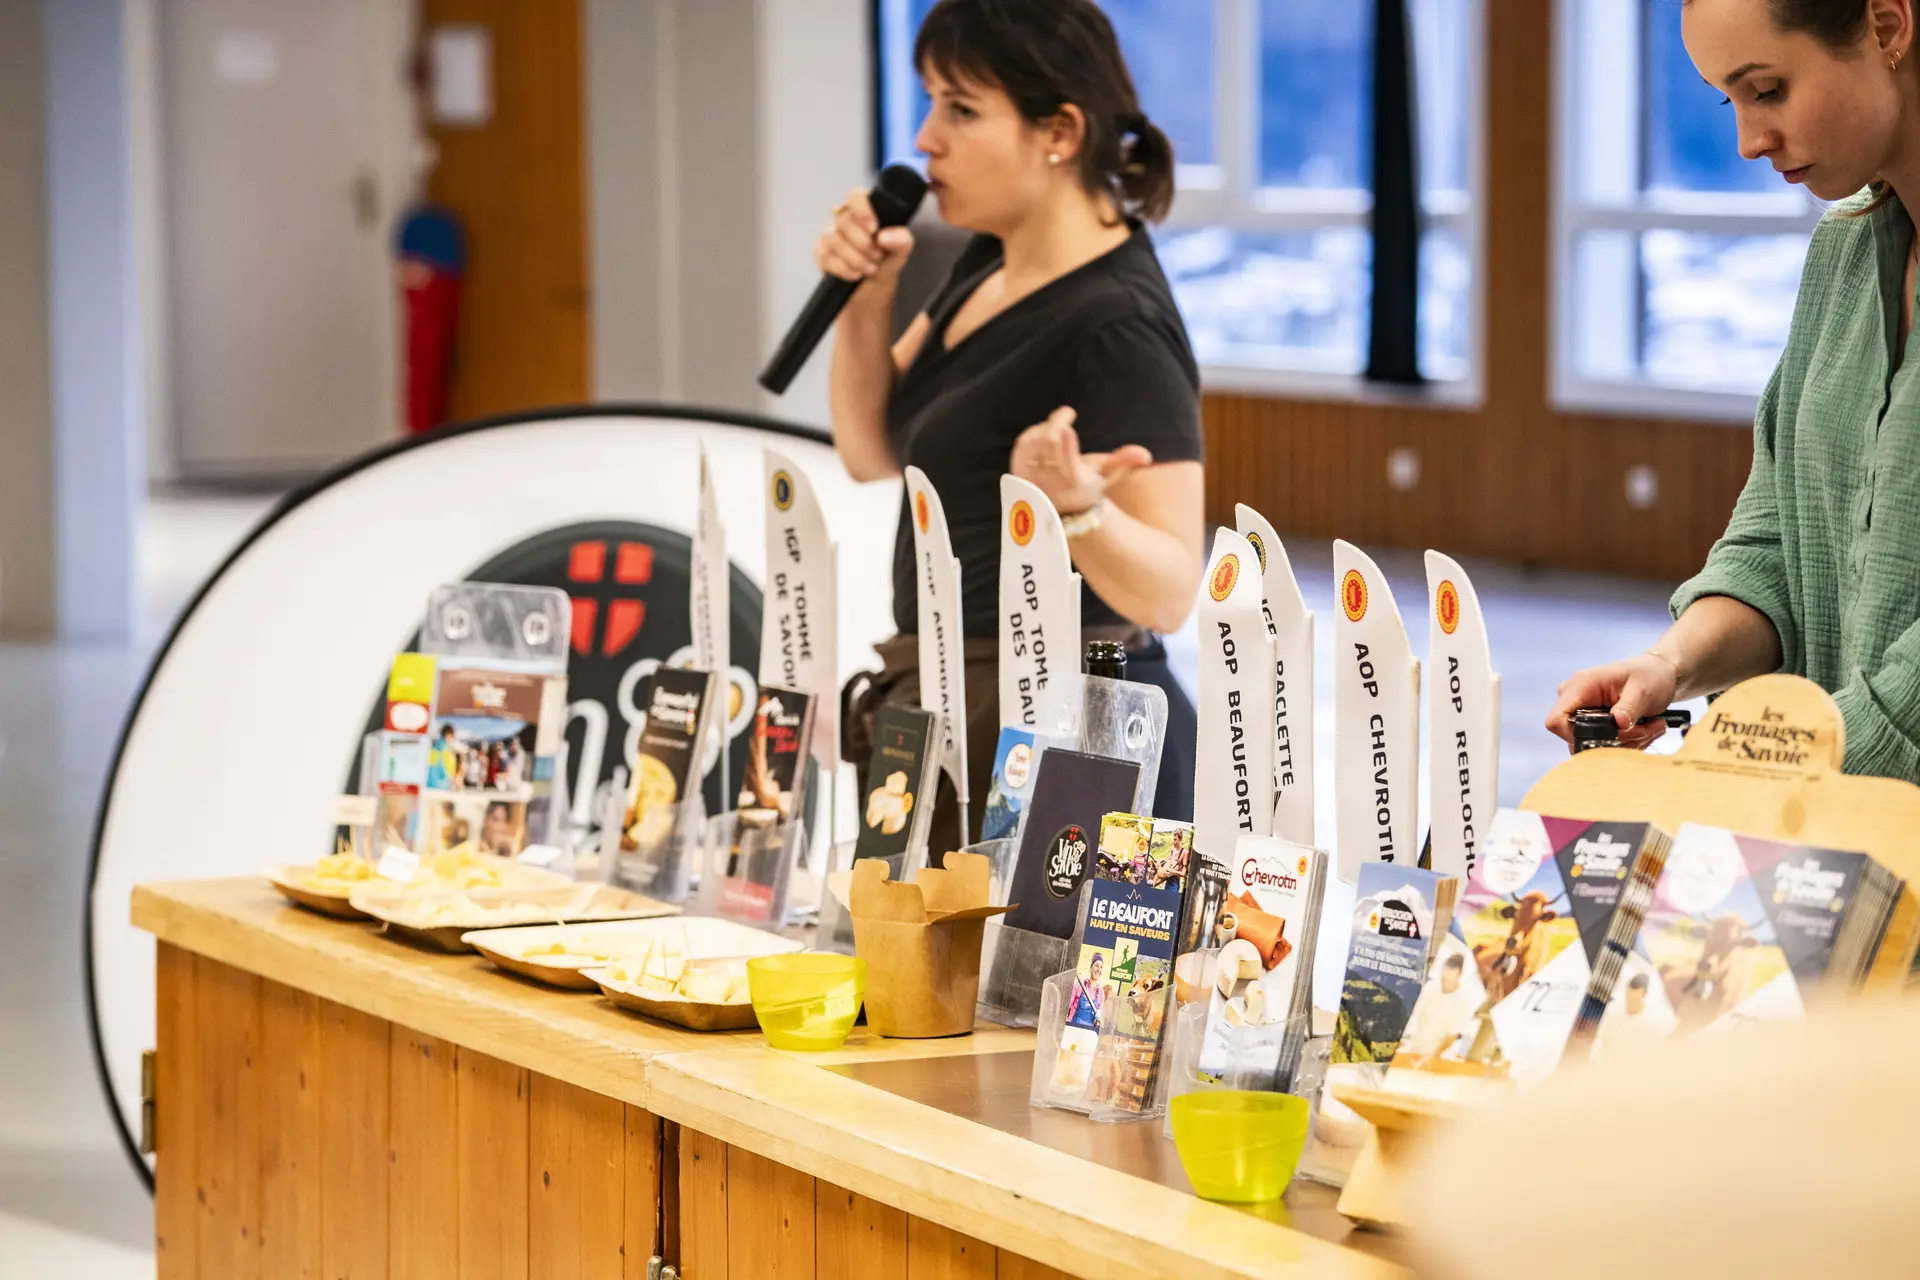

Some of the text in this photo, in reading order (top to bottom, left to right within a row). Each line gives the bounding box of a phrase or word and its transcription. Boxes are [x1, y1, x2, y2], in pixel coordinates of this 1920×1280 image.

[774, 570, 789, 599] DE
[783, 526, 812, 660] IGP TOMME
[1010, 612, 1027, 657] DES
[1021, 564, 1049, 690] AOP TOME
[1354, 642, 1379, 698] AOP
[1448, 656, 1464, 714] AOP
[1217, 621, 1253, 832] AOP BEAUFORT
[1711, 712, 1817, 745] Fromages
[1760, 705, 1786, 722] les
[1717, 736, 1810, 765] de Savoie
[1241, 858, 1297, 890] Chevrotin
[1089, 918, 1171, 941] HAUT EN SAVEURS
[1091, 897, 1174, 930] LE BEAUFORT
[1521, 981, 1552, 1012] 72
